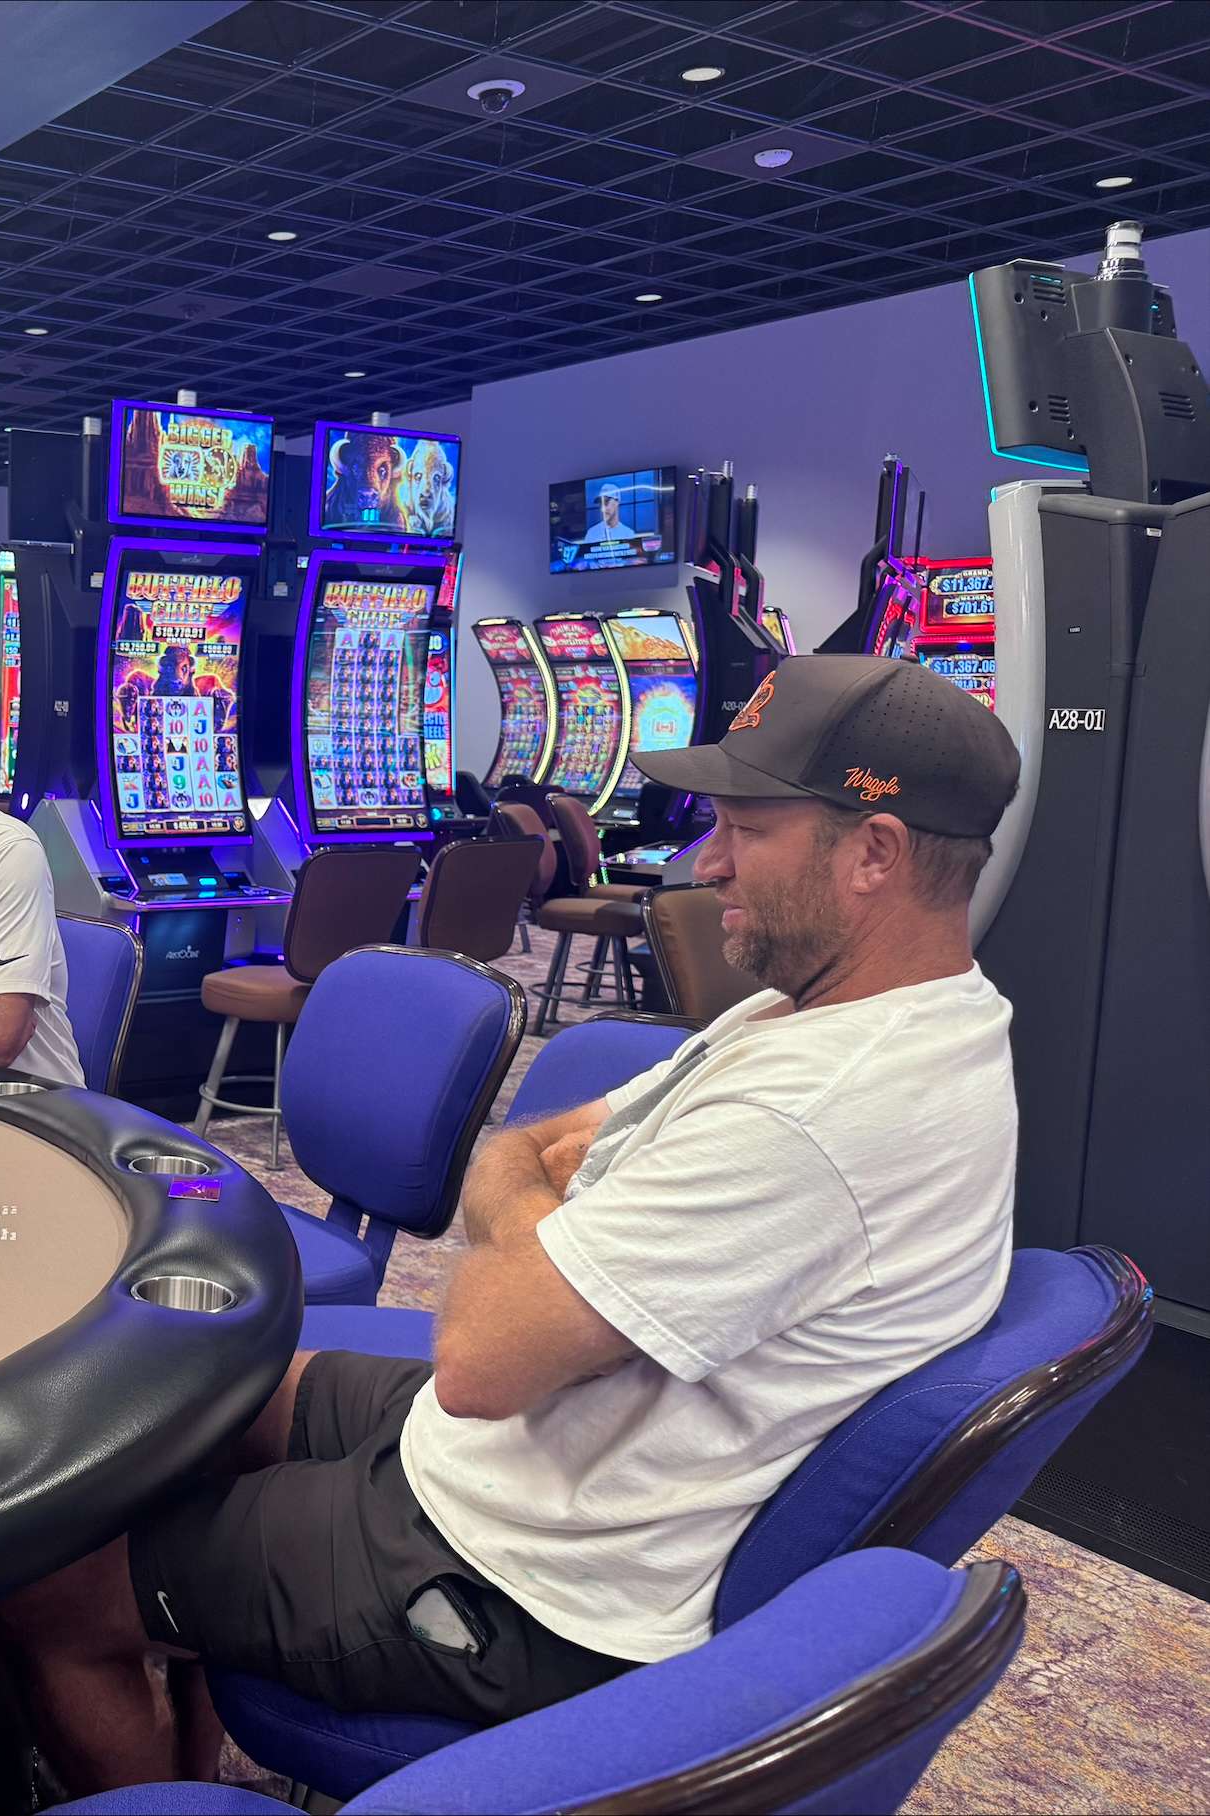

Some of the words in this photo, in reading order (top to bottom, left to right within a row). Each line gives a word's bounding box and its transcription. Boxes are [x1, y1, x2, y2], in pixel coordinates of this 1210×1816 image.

[167, 422, 233, 448] BIGGER
[126, 573, 242, 603] BUFFALO
[943, 577, 993, 591] $11,367.
[323, 582, 427, 611] BUFFALO
[952, 601, 994, 614] $701.61
[934, 660, 995, 674] $11,367.06
[1049, 709, 1102, 731] A28-01
[844, 767, 901, 801] Waggle
